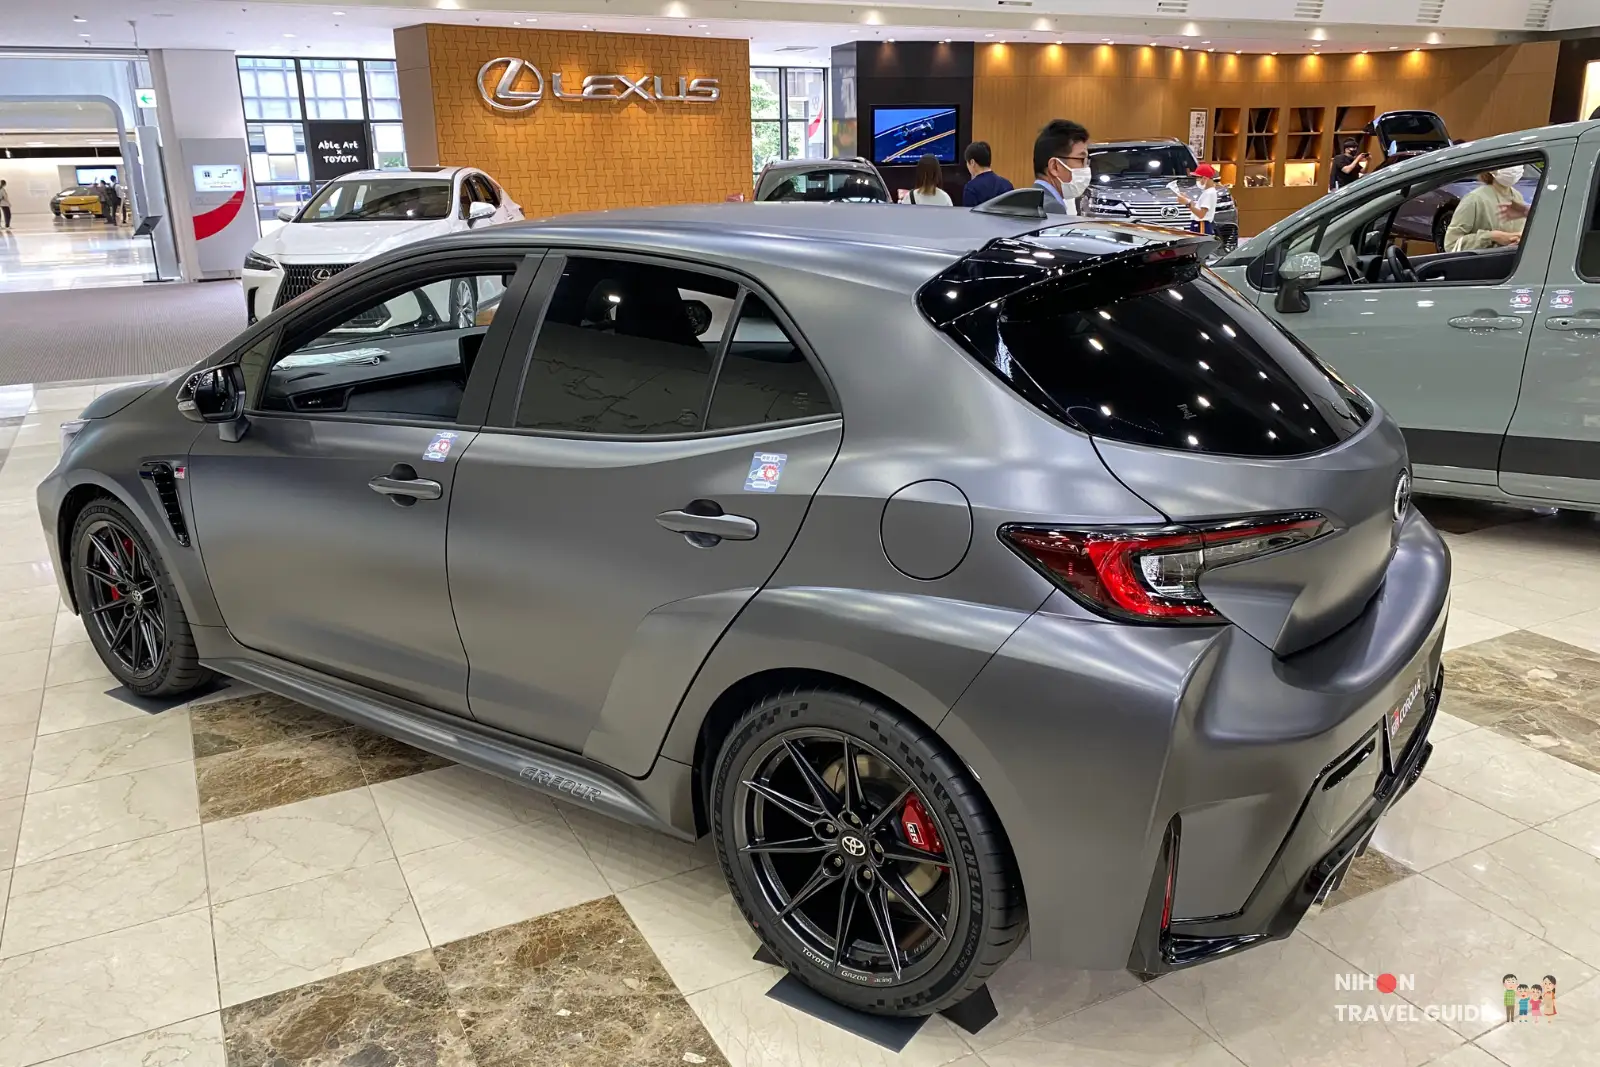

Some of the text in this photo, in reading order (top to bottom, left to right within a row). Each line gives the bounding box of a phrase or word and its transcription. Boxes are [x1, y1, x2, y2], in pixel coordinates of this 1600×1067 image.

[552, 72, 720, 101] LEXUS
[317, 139, 359, 150] Able Art
[322, 155, 359, 163] TOYOTA
[1399, 677, 1421, 724] COROLLA
[907, 823, 919, 843] GR
[948, 813, 981, 914] MICHELIN
[802, 946, 830, 969] TOYOTA
[841, 970, 867, 982] GAZOO
